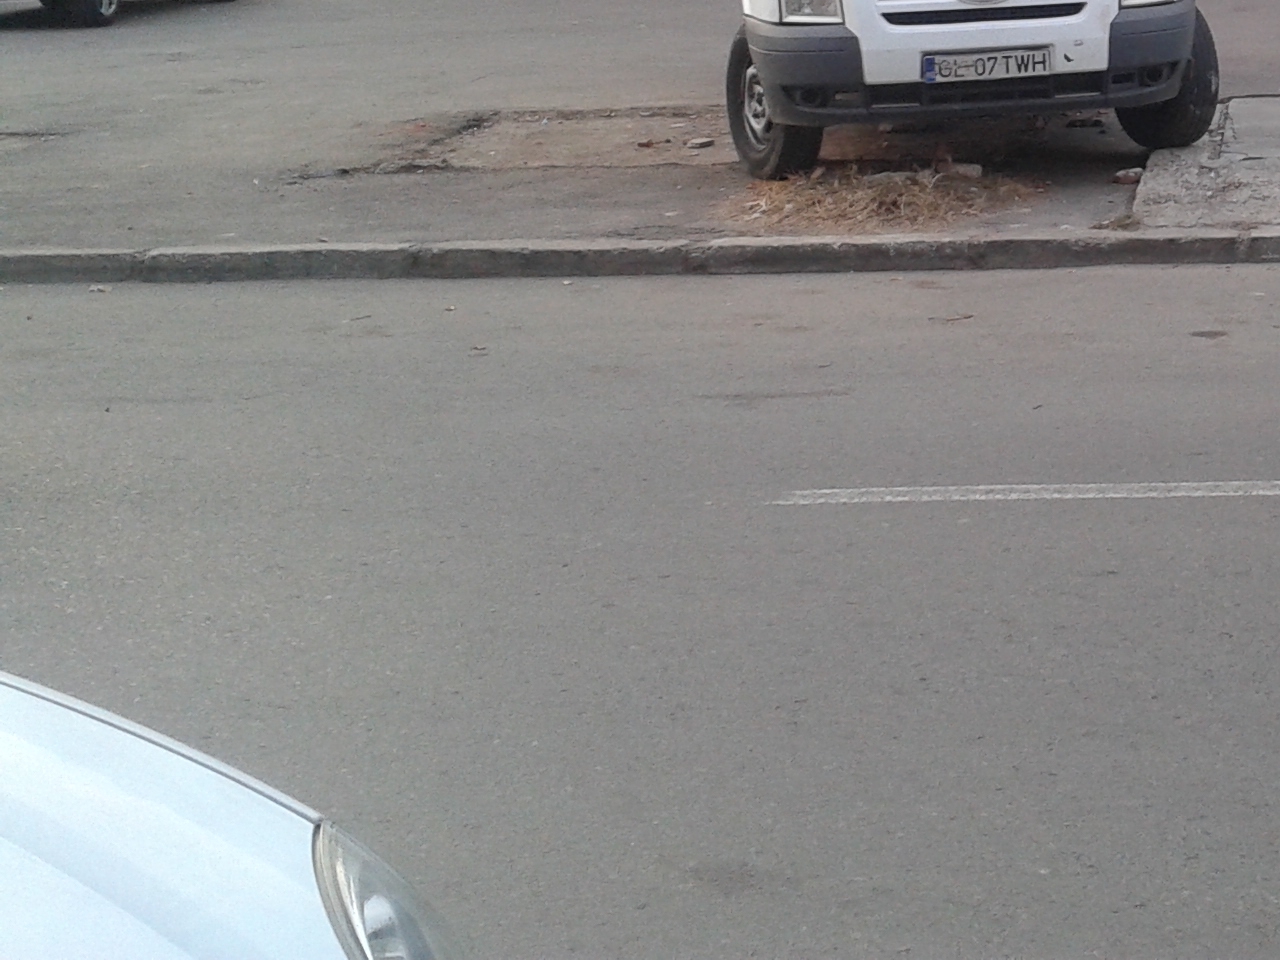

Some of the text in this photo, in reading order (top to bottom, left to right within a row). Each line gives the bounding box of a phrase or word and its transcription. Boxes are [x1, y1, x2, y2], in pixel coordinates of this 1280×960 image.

[939, 52, 1047, 78] GL 07 TWH
